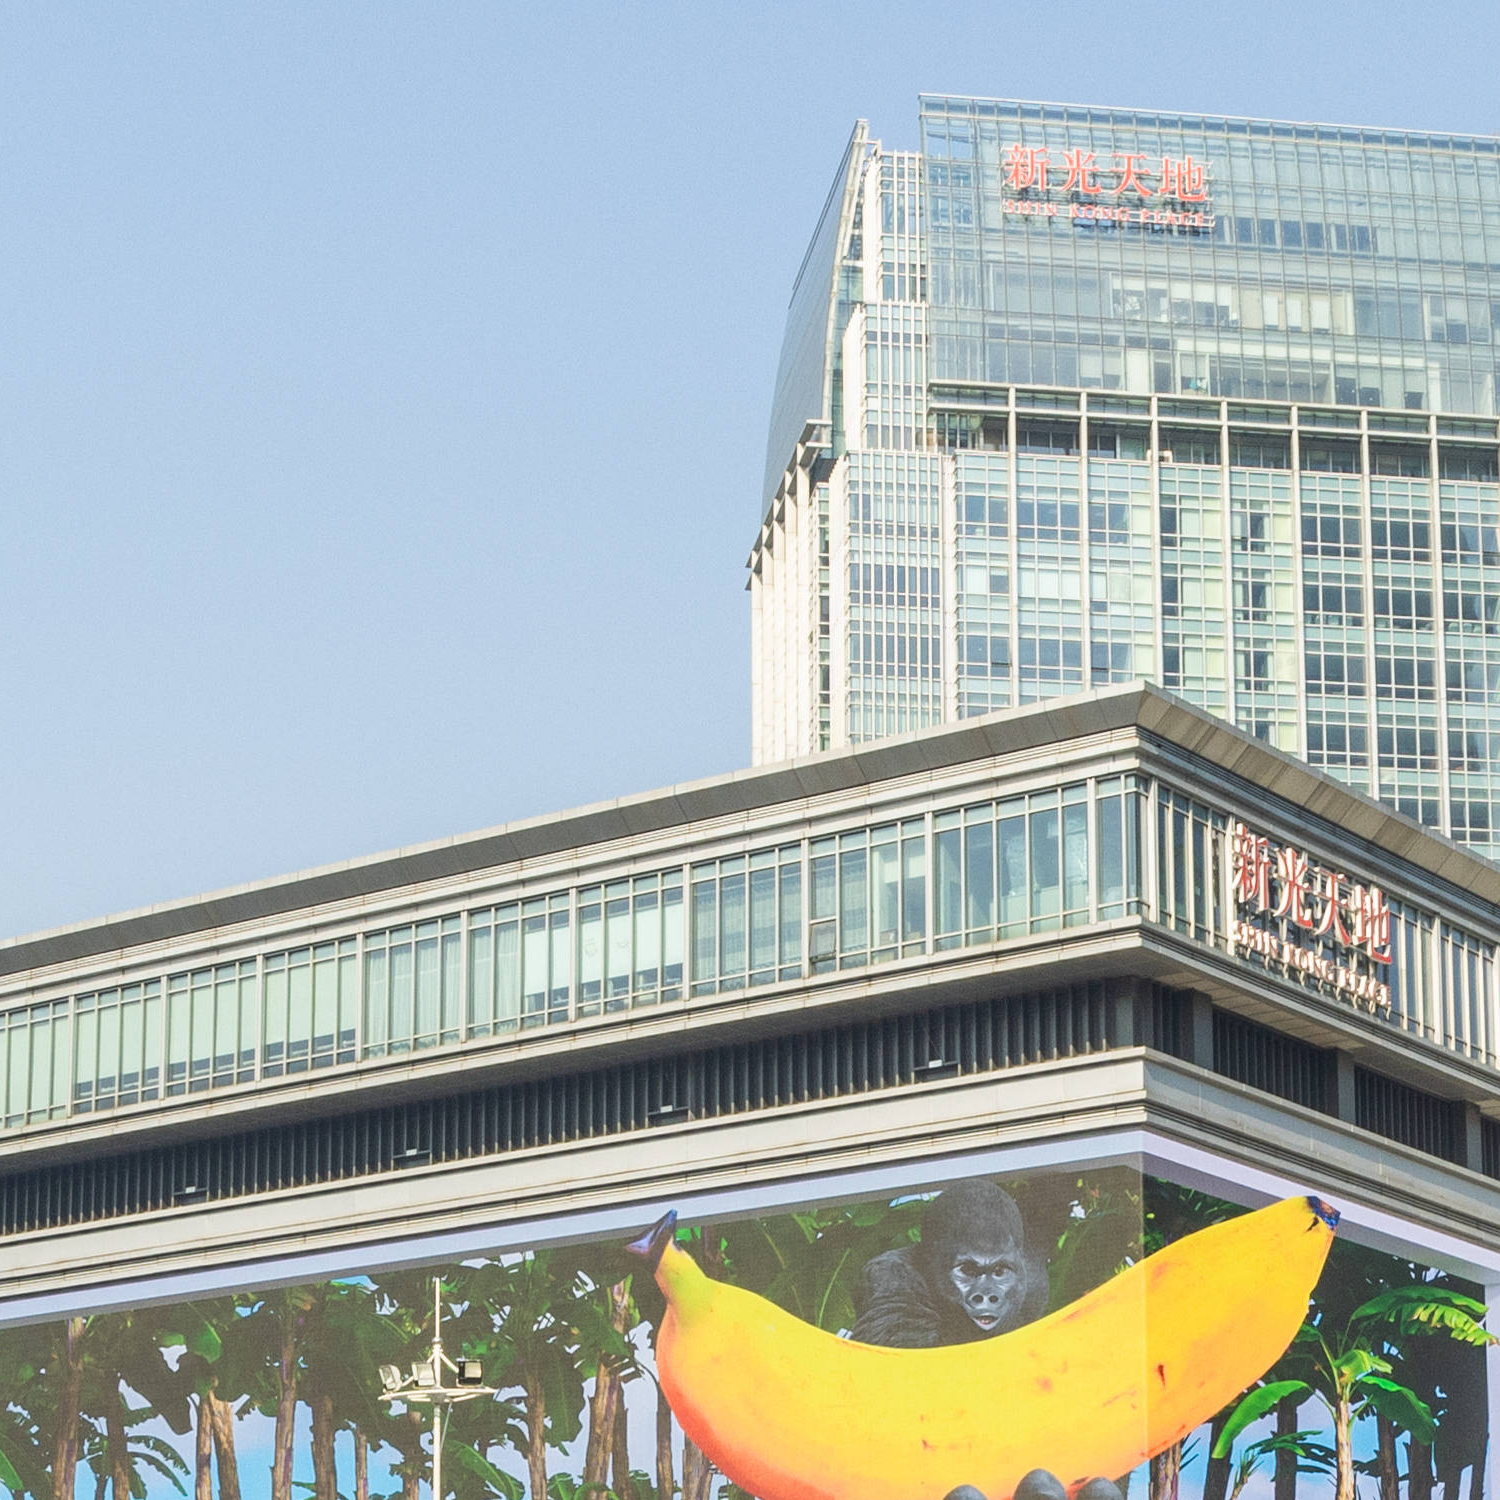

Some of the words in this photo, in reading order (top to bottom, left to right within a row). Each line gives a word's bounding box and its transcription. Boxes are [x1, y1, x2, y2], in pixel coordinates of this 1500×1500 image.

[1003, 145, 1206, 202] 新光天地
[1006, 199, 1058, 216] SHIN
[1070, 203, 1131, 221] KONG
[1140, 208, 1205, 227] PLACE
[1232, 822, 1392, 964] 新光天地
